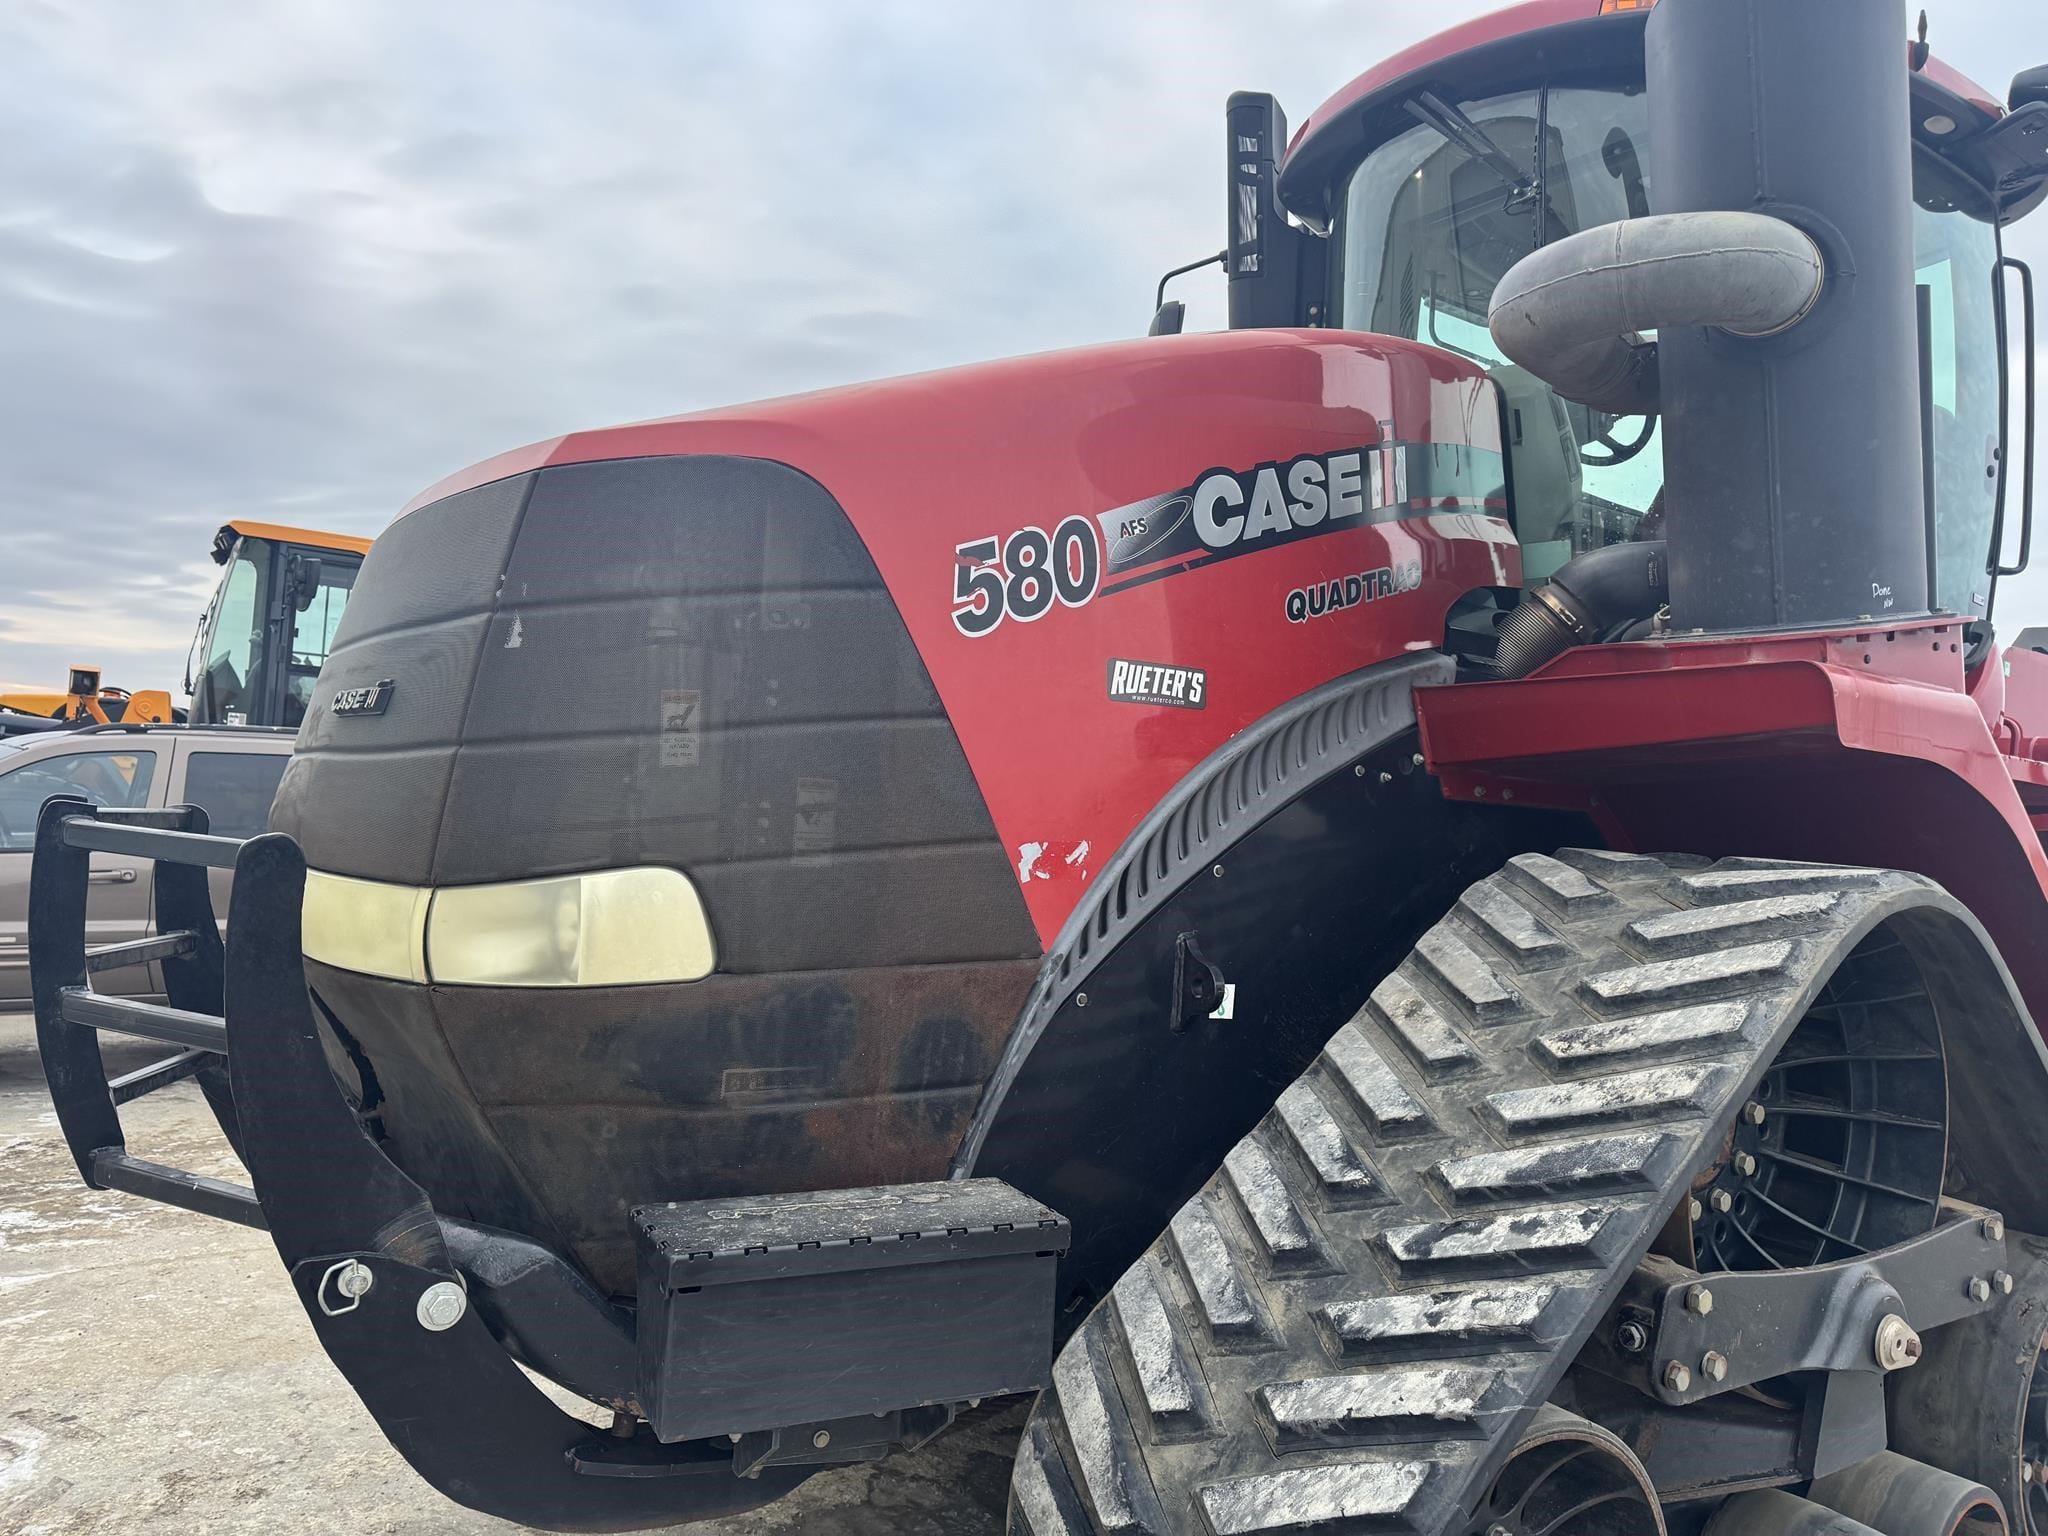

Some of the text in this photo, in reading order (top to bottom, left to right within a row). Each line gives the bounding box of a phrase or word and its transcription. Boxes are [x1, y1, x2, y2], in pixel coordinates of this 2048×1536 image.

[1119, 517, 1149, 539] AFS
[952, 515, 1100, 637] 580
[1285, 559, 1423, 624] QUADTRAC
[1111, 661, 1203, 702] RUETER'S
